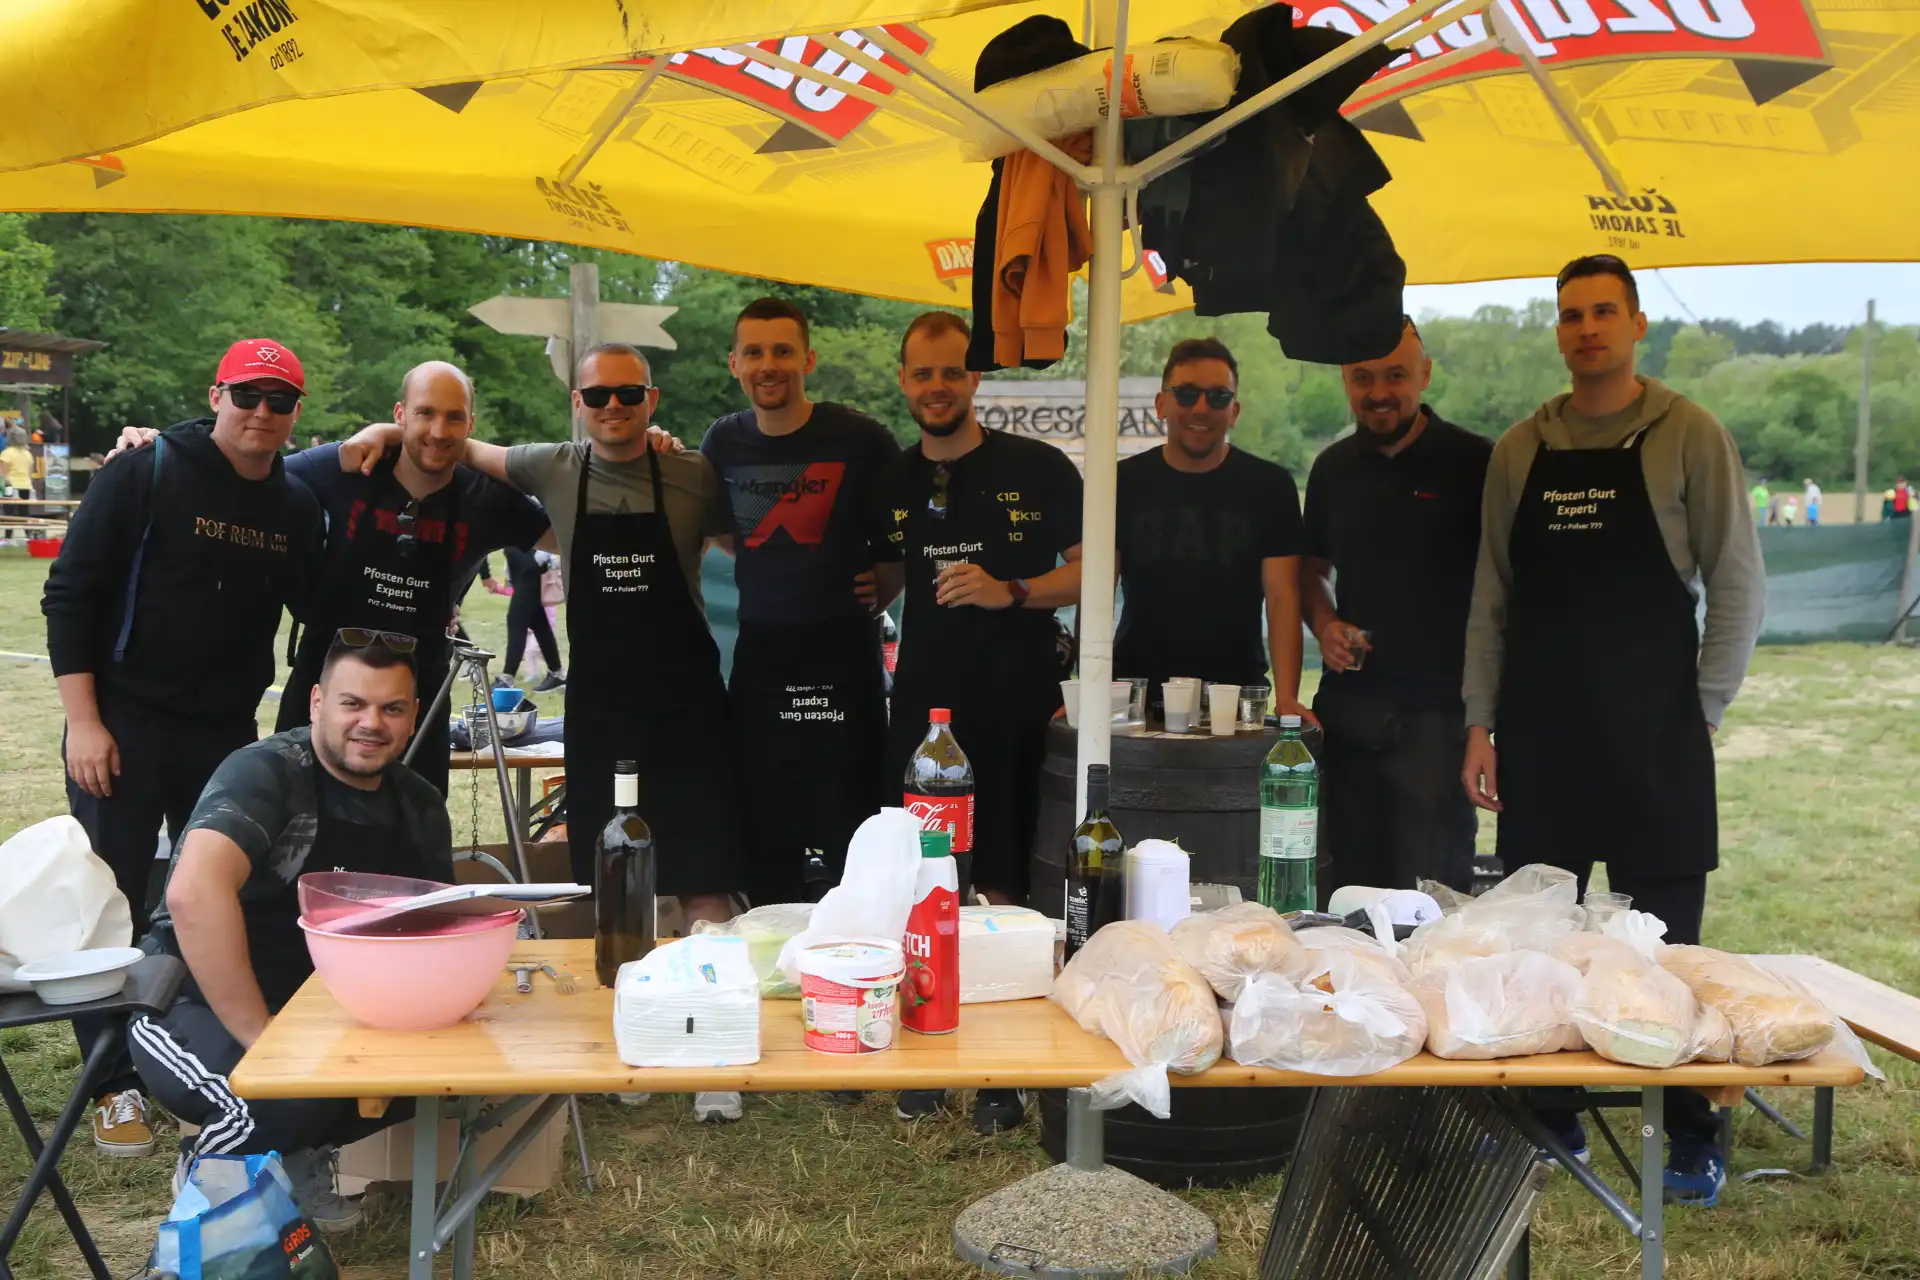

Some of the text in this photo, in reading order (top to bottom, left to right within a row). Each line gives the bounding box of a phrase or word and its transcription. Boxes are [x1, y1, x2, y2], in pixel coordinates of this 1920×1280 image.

[232, 0, 299, 48] ZAKON!
[221, 24, 249, 62] JE
[1544, 488, 1616, 503] Pfosten Gurt
[1556, 502, 1598, 517] Experti
[924, 542, 983, 558] Pfosten Gurt
[593, 554, 656, 566] Pfosten Gurt
[364, 566, 430, 588] Pfosten Gurt
[606, 567, 641, 580] Experti
[376, 584, 414, 599] Experti
[386, 602, 405, 612] Pulver
[792, 696, 828, 708] Experti
[780, 708, 844, 722] Pfosten Gurt
